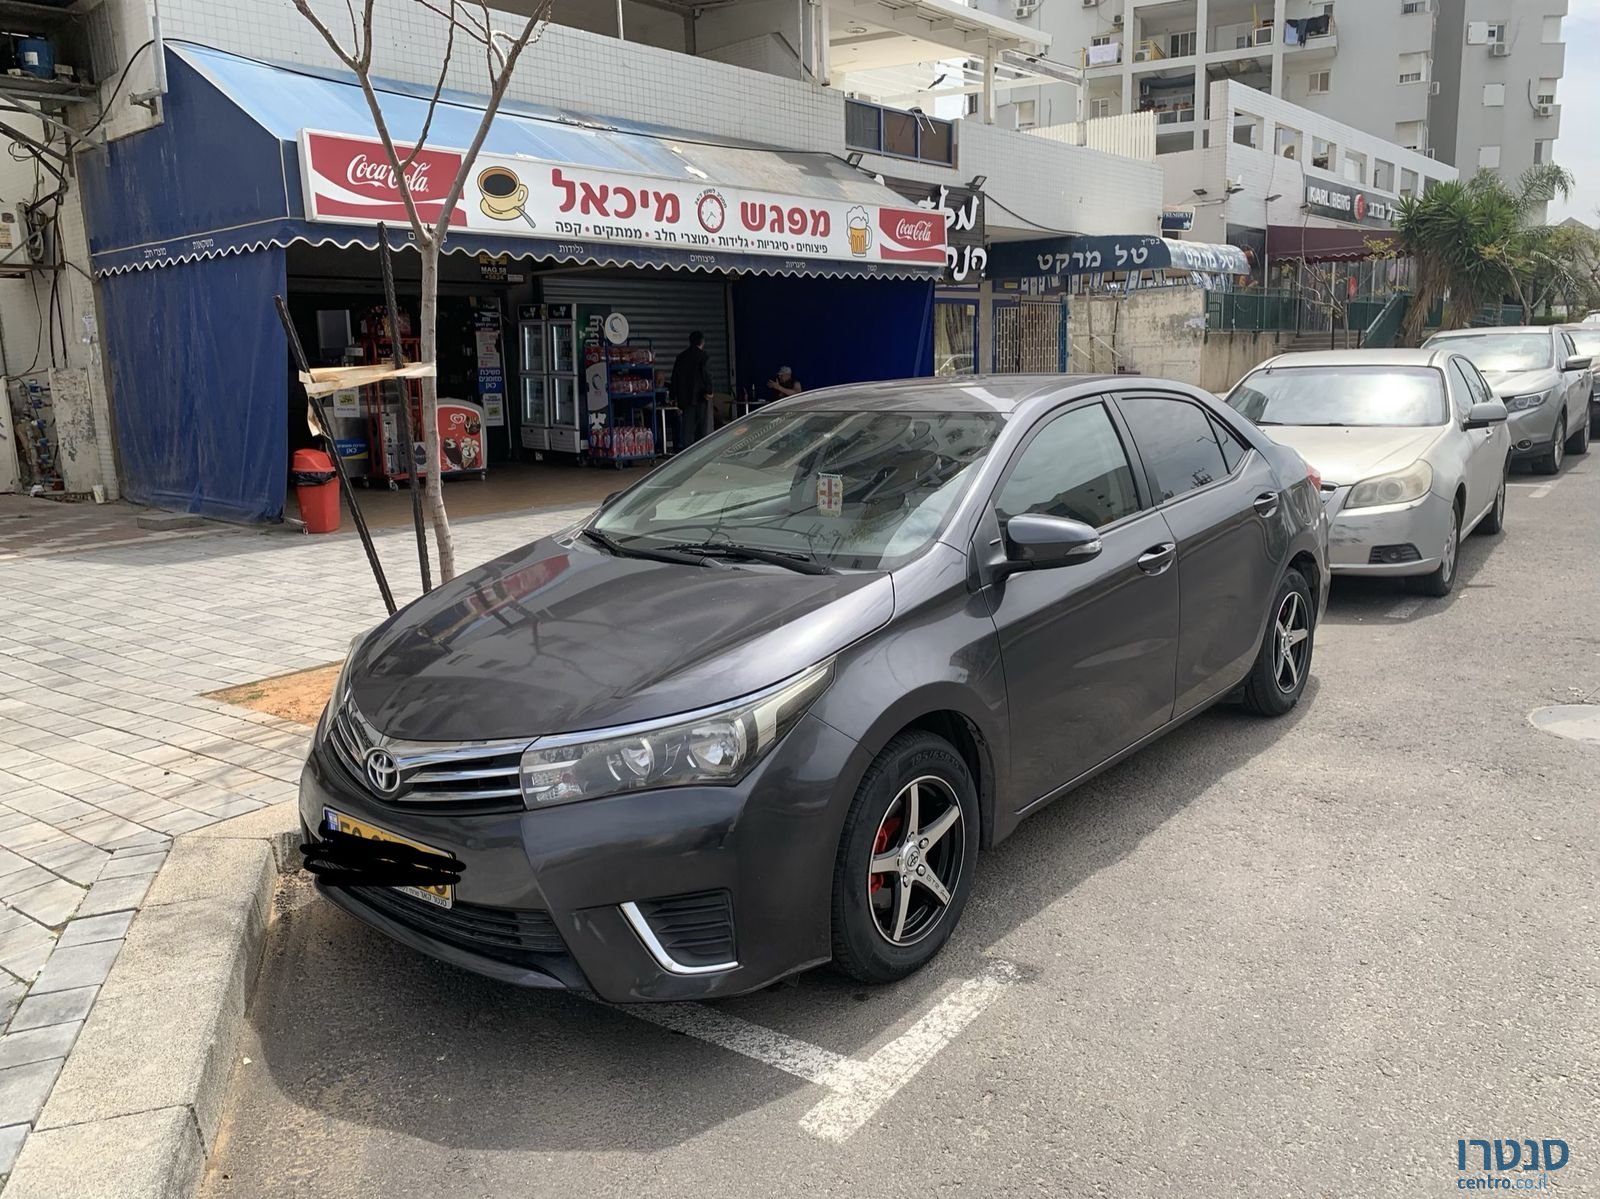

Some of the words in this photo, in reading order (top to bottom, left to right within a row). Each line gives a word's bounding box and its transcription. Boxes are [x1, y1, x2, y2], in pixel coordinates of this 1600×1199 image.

[551, 168, 681, 224] מיכאל
[740, 201, 831, 238] מפגש
[555, 221, 582, 237] קפה
[593, 225, 642, 240] ממתקים
[654, 228, 677, 242] חלב
[895, 218, 933, 241] Coca-Cola
[680, 232, 709, 245] מוצרי
[718, 235, 749, 248] גלידות
[756, 239, 789, 251] סיגריות
[558, 244, 584, 254] גלידות
[796, 241, 828, 254] פיצוחים
[690, 253, 715, 264] פיצוחים
[1036, 250, 1102, 274] מרקט
[1114, 244, 1149, 266] טל
[1185, 250, 1217, 270] מרקט
[785, 260, 806, 269] סיגריות
[485, 382, 497, 390] כאן
